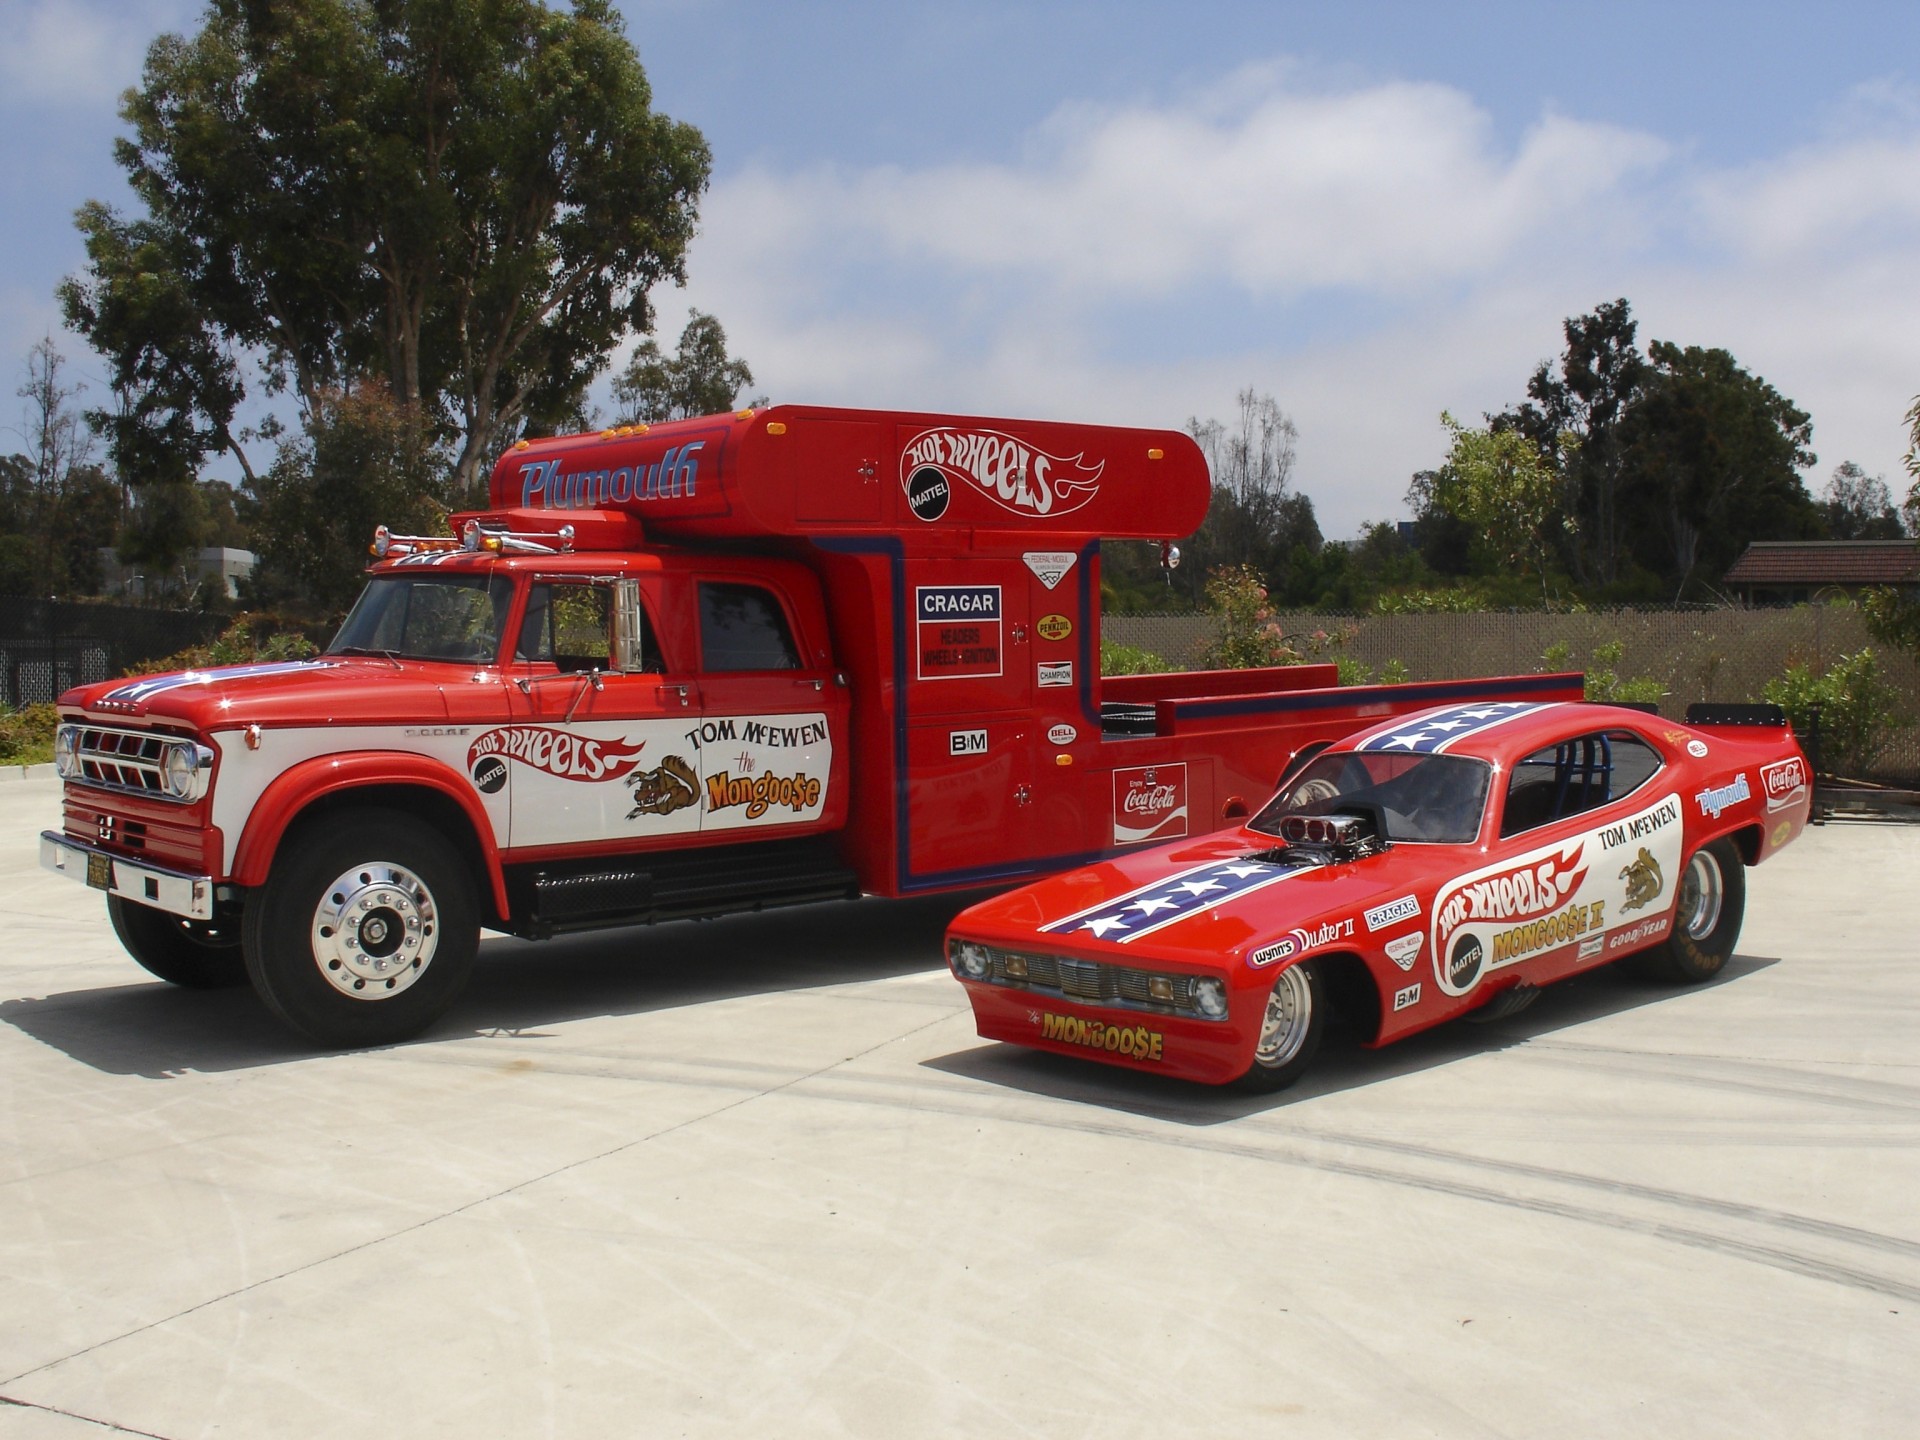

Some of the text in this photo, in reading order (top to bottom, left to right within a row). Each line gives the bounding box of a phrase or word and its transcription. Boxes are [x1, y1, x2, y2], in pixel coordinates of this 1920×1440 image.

[519, 441, 706, 511] Plymouth
[910, 483, 948, 509] MATTEL
[924, 594, 994, 612] CRAGAR
[940, 628, 980, 645] HEADERS
[1039, 621, 1069, 633] PENNZOIL
[1040, 669, 1071, 680] CHAMPION
[685, 720, 735, 751] TOM
[1051, 728, 1074, 736] BELL
[733, 751, 756, 773] the
[475, 764, 507, 788] MATTEL
[1695, 773, 1751, 820] Plymouth
[1598, 825, 1626, 851] TOM
[1369, 901, 1416, 926] CRAGAR
[1589, 900, 1605, 931] II
[1288, 918, 1355, 952] Duster II
[1610, 919, 1668, 948] GOODYEAR
[1450, 944, 1482, 977] MATTEL
